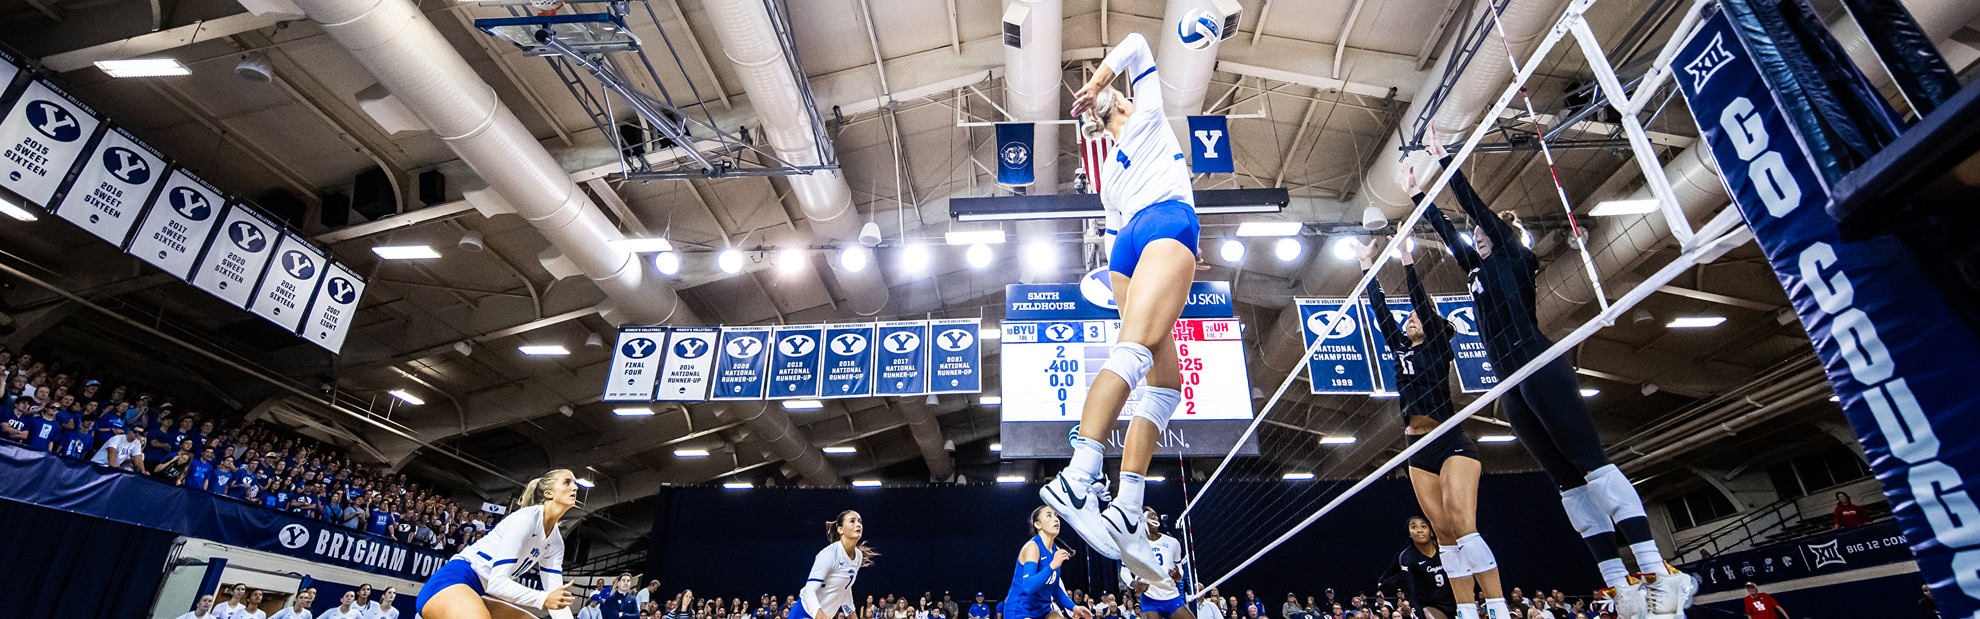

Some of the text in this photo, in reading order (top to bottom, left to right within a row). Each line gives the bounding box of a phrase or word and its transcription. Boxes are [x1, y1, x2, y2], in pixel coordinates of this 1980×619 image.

[39, 103, 76, 137] Y
[24, 137, 50, 155] 2015
[1195, 131, 1222, 158] Y
[14, 144, 48, 166] SWEET
[1720, 97, 1801, 218] GO
[4, 150, 47, 177] SIXTEEN
[114, 150, 146, 180] Y
[94, 188, 122, 208] SWEET
[100, 182, 123, 198] 2016
[84, 194, 121, 218] SIXTEEN
[180, 189, 207, 217] Y
[168, 220, 188, 234] 2017
[154, 232, 186, 253] SIXTEEN
[162, 227, 187, 244] SWEET
[238, 223, 263, 249] Y
[222, 258, 245, 274] SWEET
[228, 252, 246, 266] 2020
[289, 253, 312, 277] Y
[215, 265, 244, 284] SIXTEEN
[276, 286, 296, 300] SWEET
[280, 280, 296, 292] 2021
[334, 279, 353, 302] Y
[269, 292, 296, 310] SIXTEEN
[1028, 292, 1059, 300] SMITH
[1198, 294, 1226, 305] SKIN
[1012, 302, 1076, 310] FIELDHOUSE
[320, 319, 337, 331] EIGHT
[323, 312, 338, 324] ELITE
[1013, 326, 1035, 334] BYU
[1051, 326, 1068, 339] Y
[1090, 326, 1098, 338] 3
[1214, 323, 1228, 332] UH
[733, 339, 756, 356] Y
[786, 337, 809, 354] Y
[837, 336, 860, 353] Y
[890, 334, 914, 350] Y
[943, 332, 967, 348] Y
[628, 340, 652, 357] Y
[680, 340, 704, 357] Y
[1056, 345, 1065, 358] 2
[1180, 344, 1188, 356] 6
[1044, 360, 1078, 373] .400
[1050, 374, 1074, 386] 0.0
[1058, 389, 1067, 401] 0
[1185, 387, 1193, 400] 0
[1060, 403, 1066, 416] 1
[1186, 401, 1196, 414] 2
[286, 527, 305, 546] Y
[314, 529, 406, 572] BRIGHAM
[1846, 543, 1864, 554] BIG
[1866, 540, 1880, 549] 12
[1155, 553, 1163, 566] 3
[1435, 574, 1444, 587] 9
